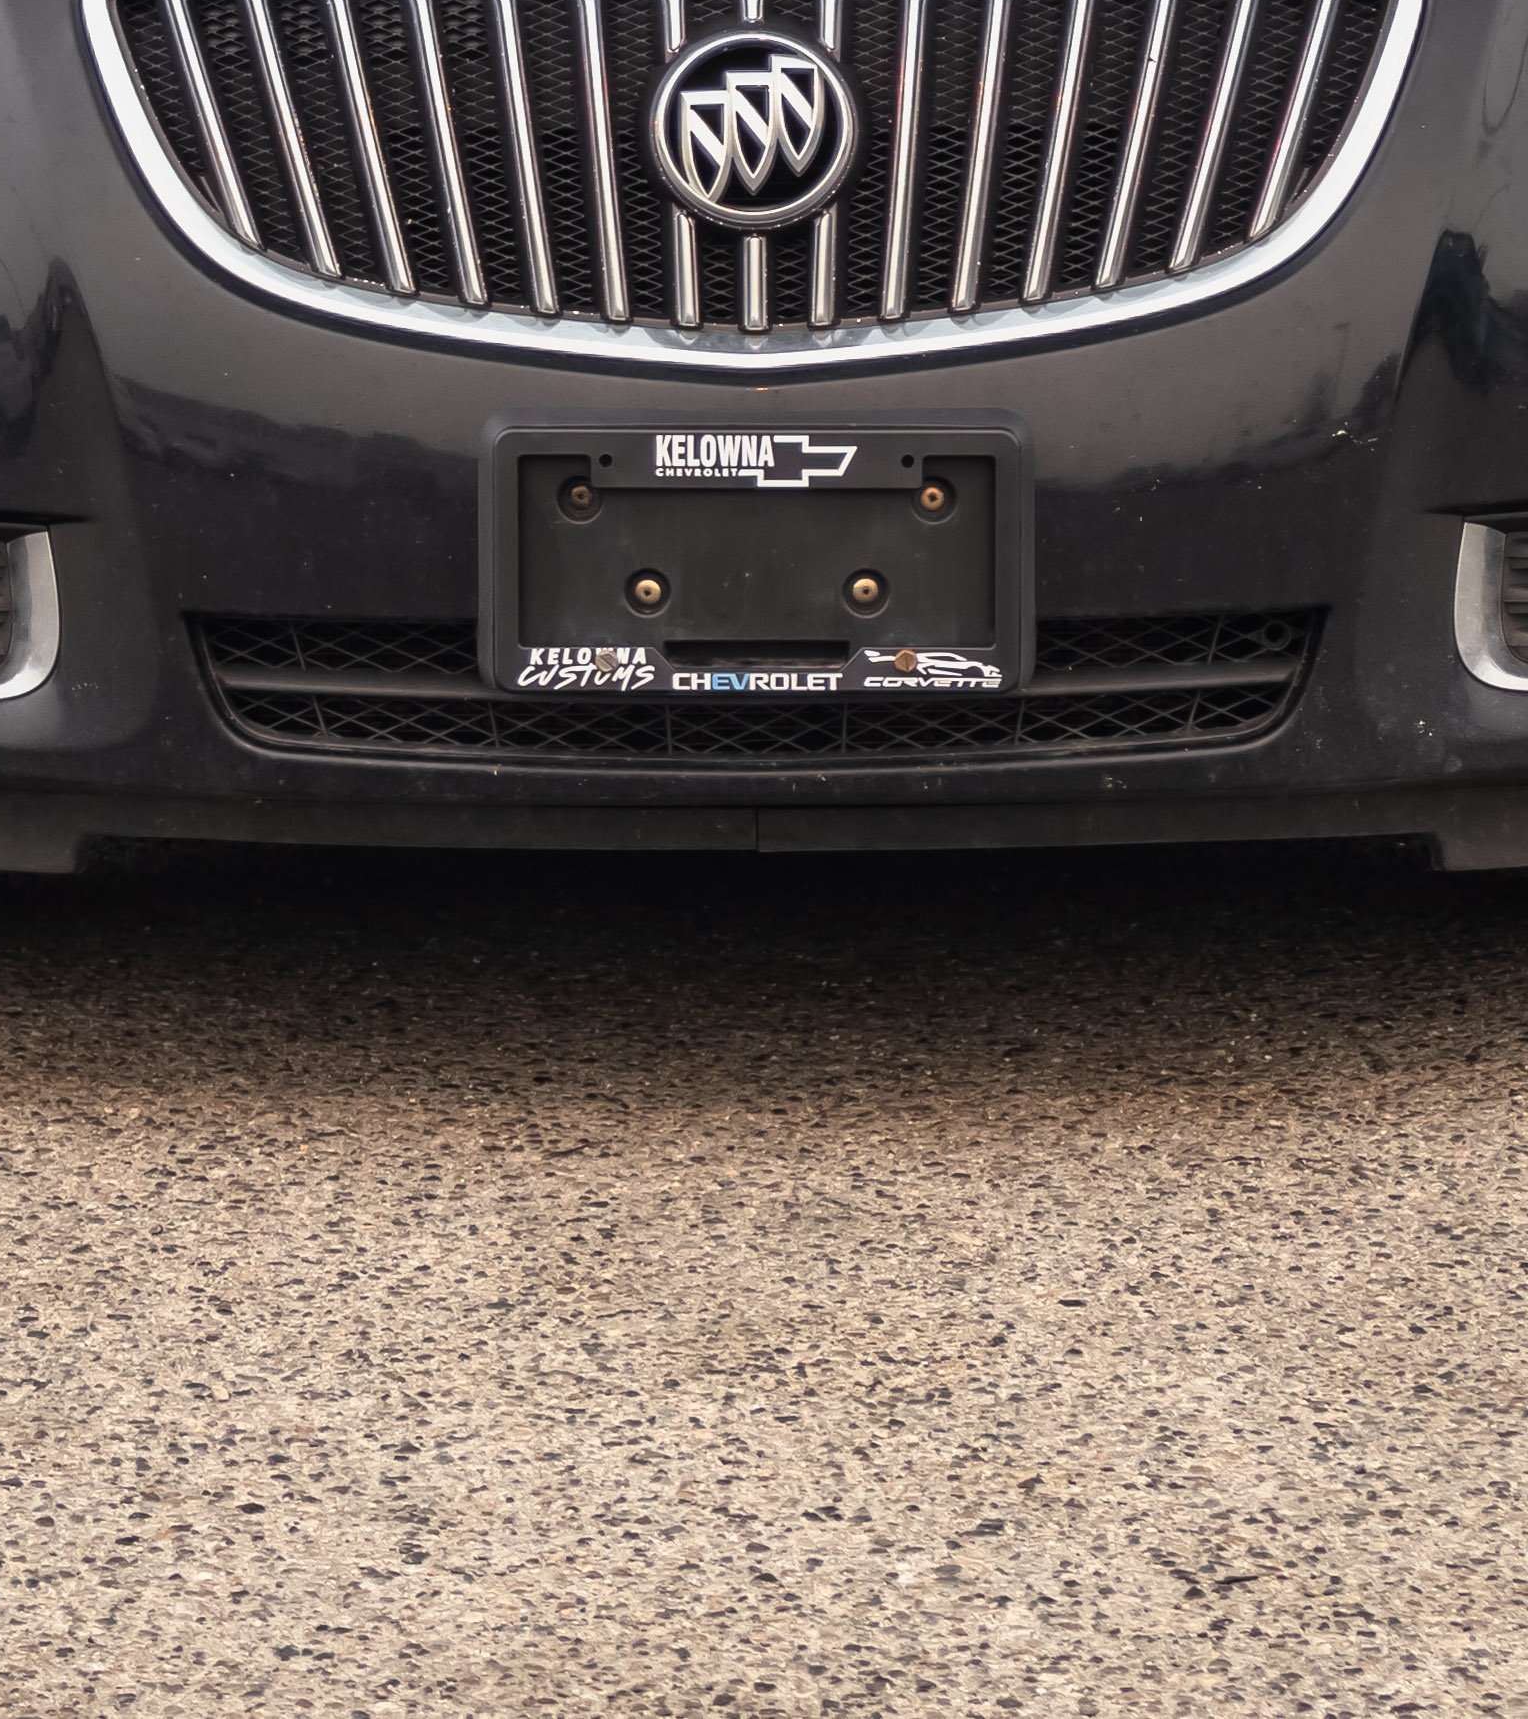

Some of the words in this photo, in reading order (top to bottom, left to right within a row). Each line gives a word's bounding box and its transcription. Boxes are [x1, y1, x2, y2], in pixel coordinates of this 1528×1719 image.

[655, 434, 775, 467] KELOWNA
[655, 468, 738, 477] CHEVROLET
[672, 672, 843, 691] CHEVROLET
[863, 676, 1002, 688] CORVETTE
